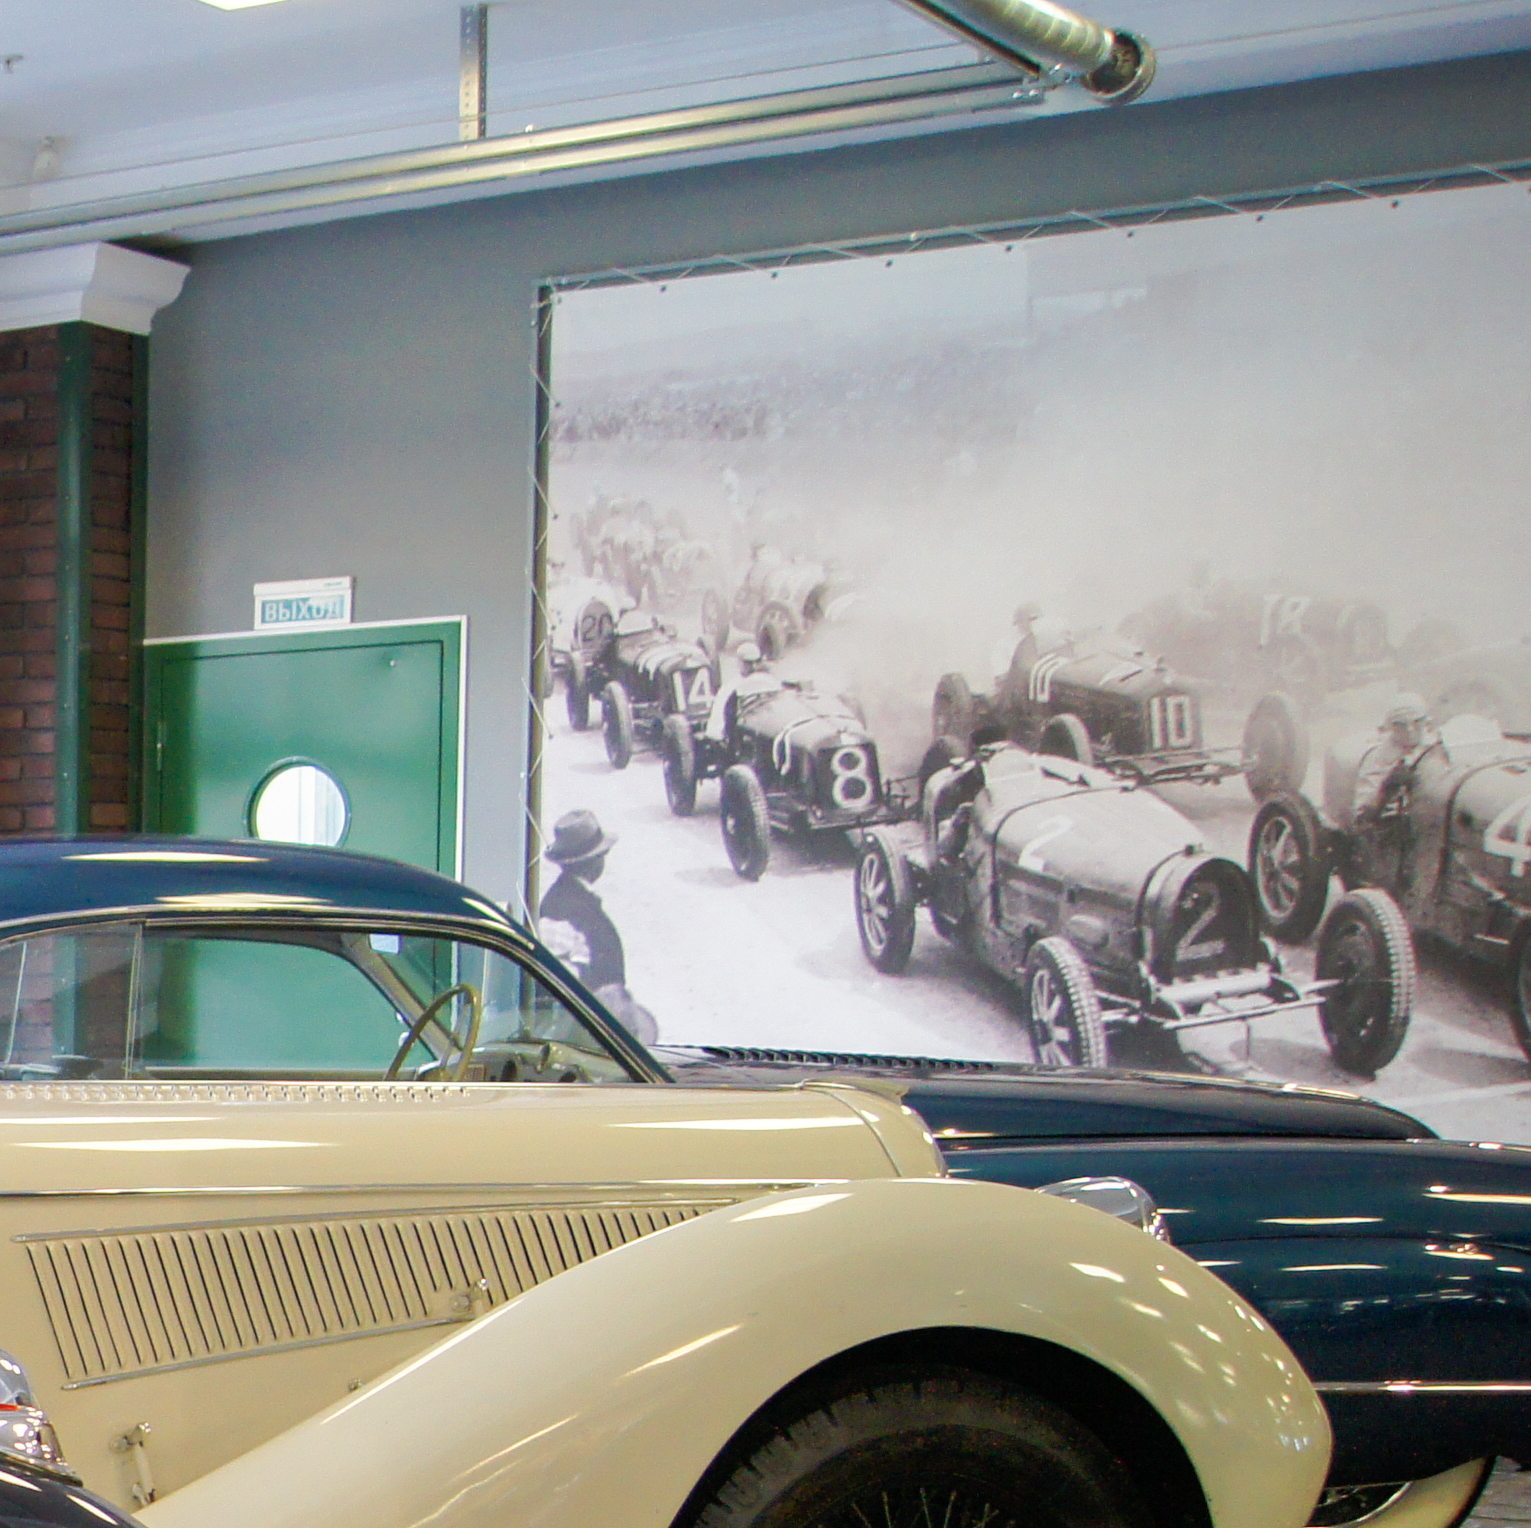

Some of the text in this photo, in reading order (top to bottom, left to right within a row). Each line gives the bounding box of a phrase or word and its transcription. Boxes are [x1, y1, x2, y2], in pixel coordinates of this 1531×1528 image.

[265, 600, 341, 622] ВЫХОД
[673, 666, 713, 712] 14
[1150, 695, 1193, 749] 10
[831, 746, 873, 808] 8
[1176, 880, 1227, 962] 2
